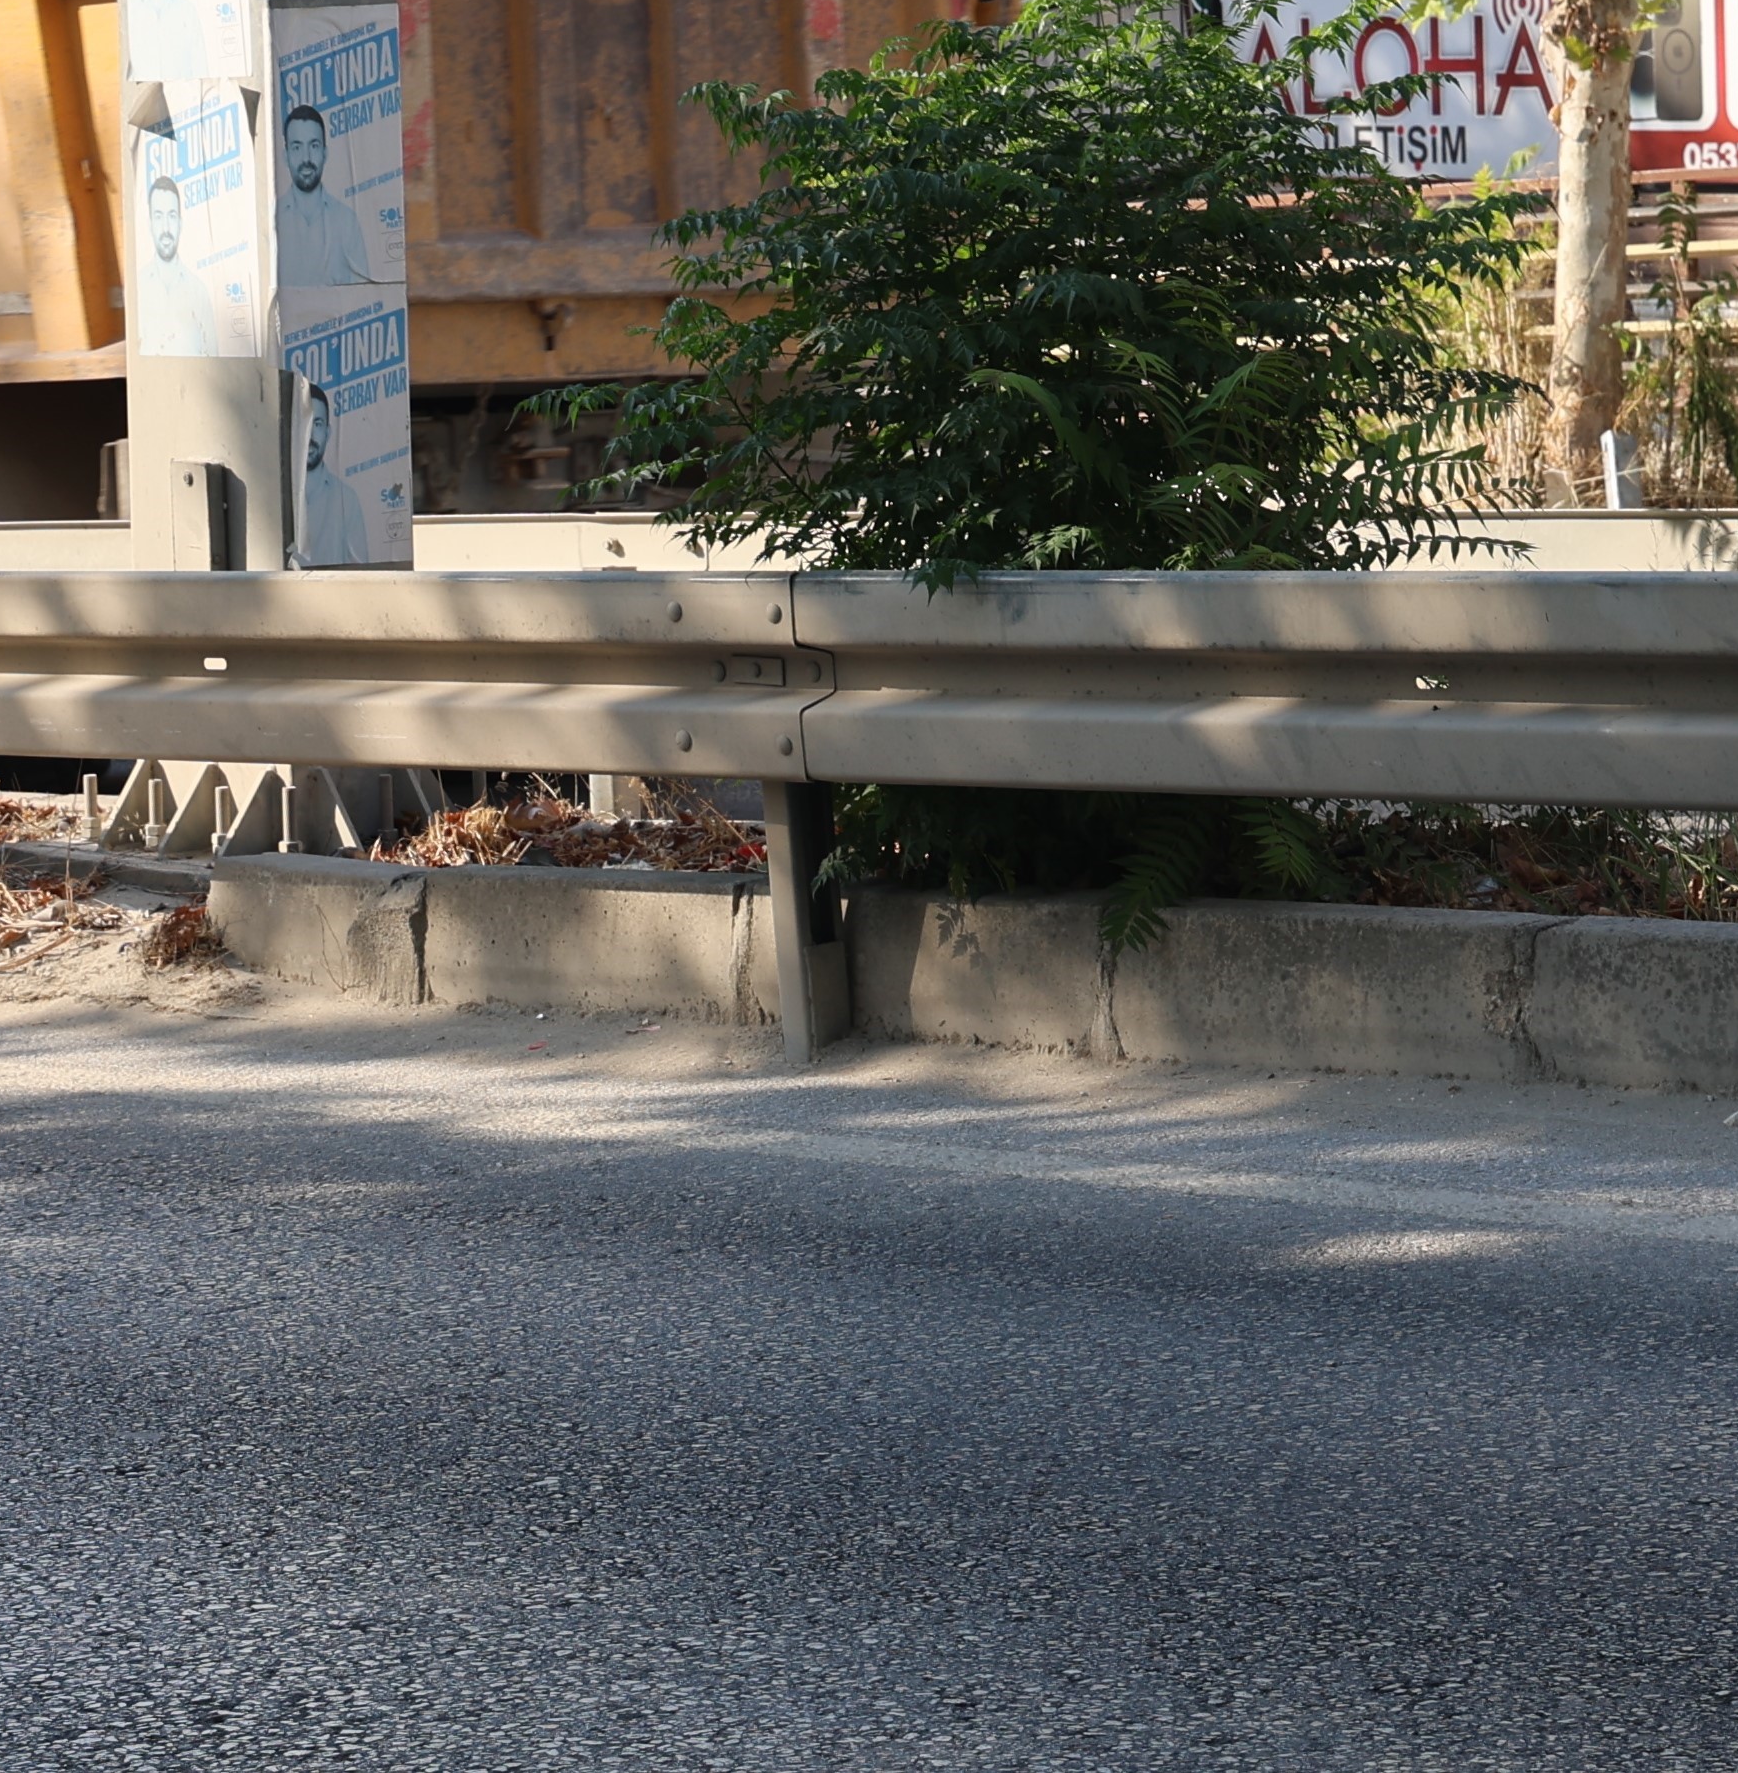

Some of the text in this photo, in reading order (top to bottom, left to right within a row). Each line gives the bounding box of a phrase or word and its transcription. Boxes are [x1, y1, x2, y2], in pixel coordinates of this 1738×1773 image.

[285, 35, 395, 115] SOL'UNDA
[1250, 14, 1555, 117] ALOHA
[329, 86, 402, 139] SERBAY VAR
[149, 109, 237, 185] SOL'UNDA
[183, 161, 243, 210] SERBAY VAR
[379, 207, 403, 223] SOL
[290, 316, 400, 385] SOL'UNDA
[333, 366, 407, 417] SERBAY VAR
